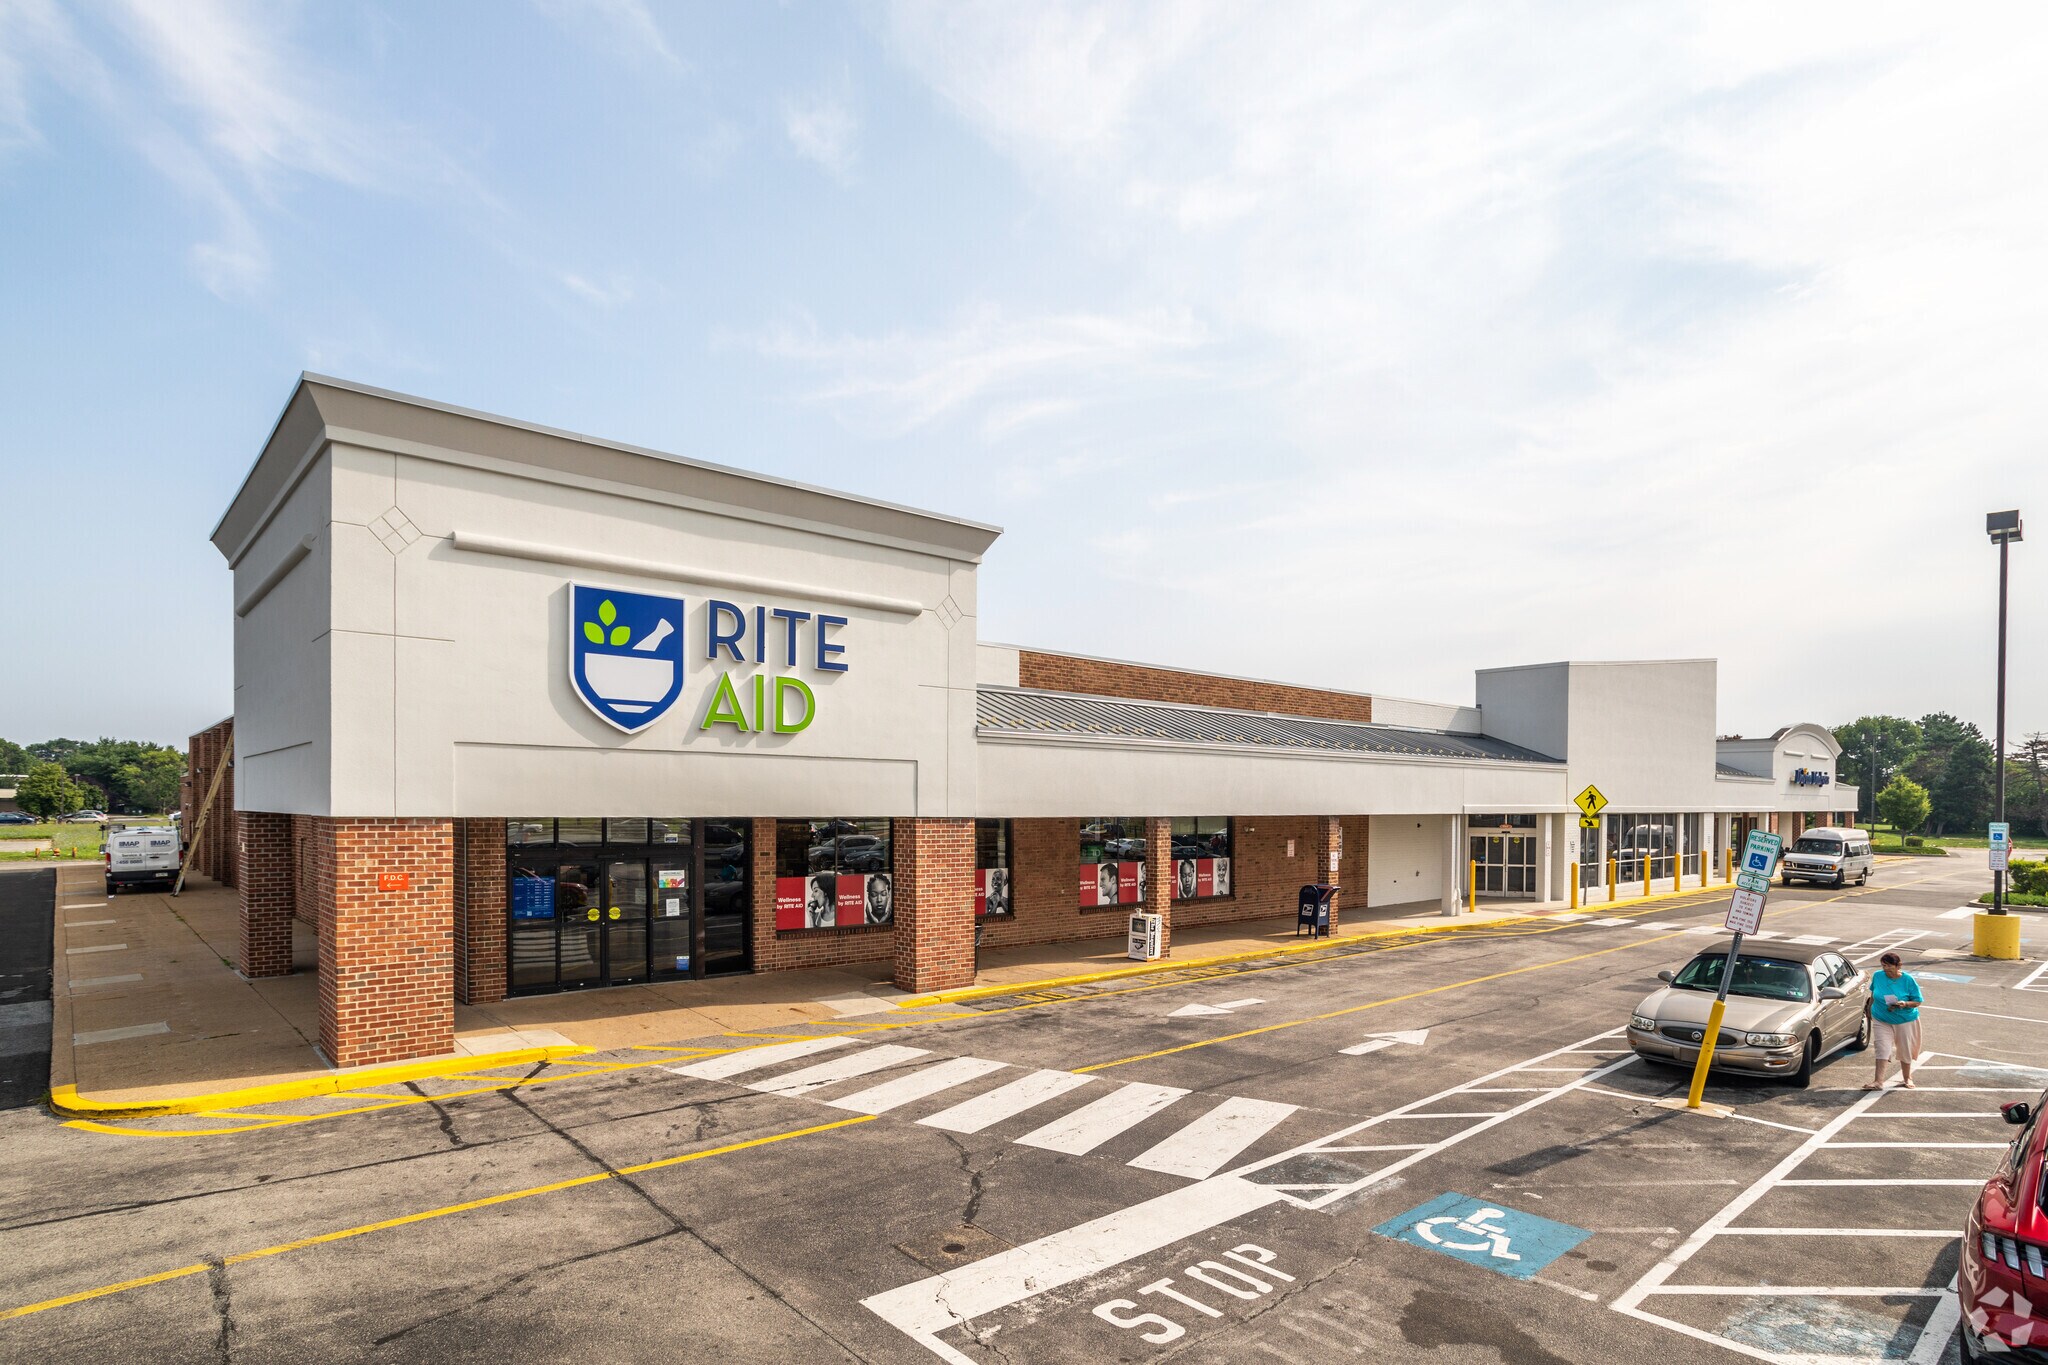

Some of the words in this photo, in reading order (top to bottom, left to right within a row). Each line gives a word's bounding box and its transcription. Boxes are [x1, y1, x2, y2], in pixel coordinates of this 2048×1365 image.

[706, 599, 849, 672] RITE
[700, 671, 816, 734] AID
[1750, 834, 1778, 846] RESERVED
[1750, 843, 1774, 854] PARKING
[1091, 1243, 1297, 1345] STOP
